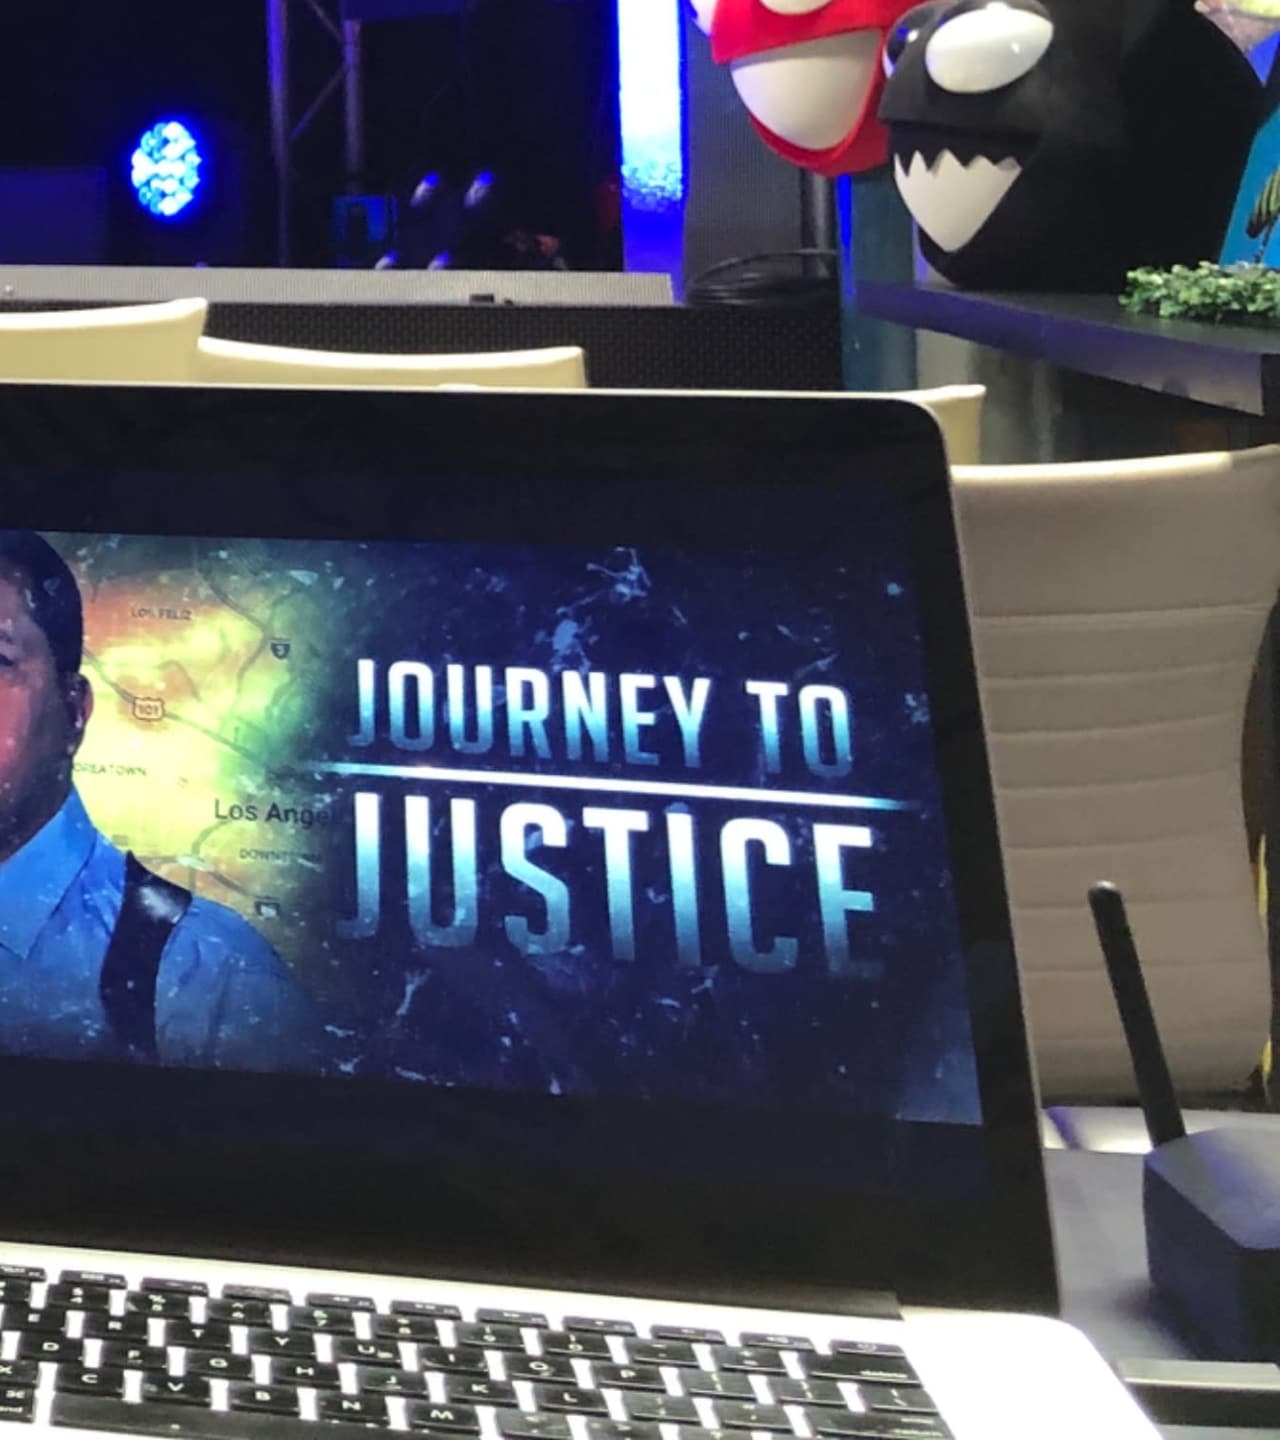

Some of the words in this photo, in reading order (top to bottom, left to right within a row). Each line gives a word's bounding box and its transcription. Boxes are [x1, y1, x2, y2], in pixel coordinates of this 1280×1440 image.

[158, 607, 193, 621] FELIZ
[348, 657, 712, 769] JOURNEY
[745, 681, 854, 778] TO
[215, 799, 259, 822] Los
[337, 791, 886, 982] JUSTICE
